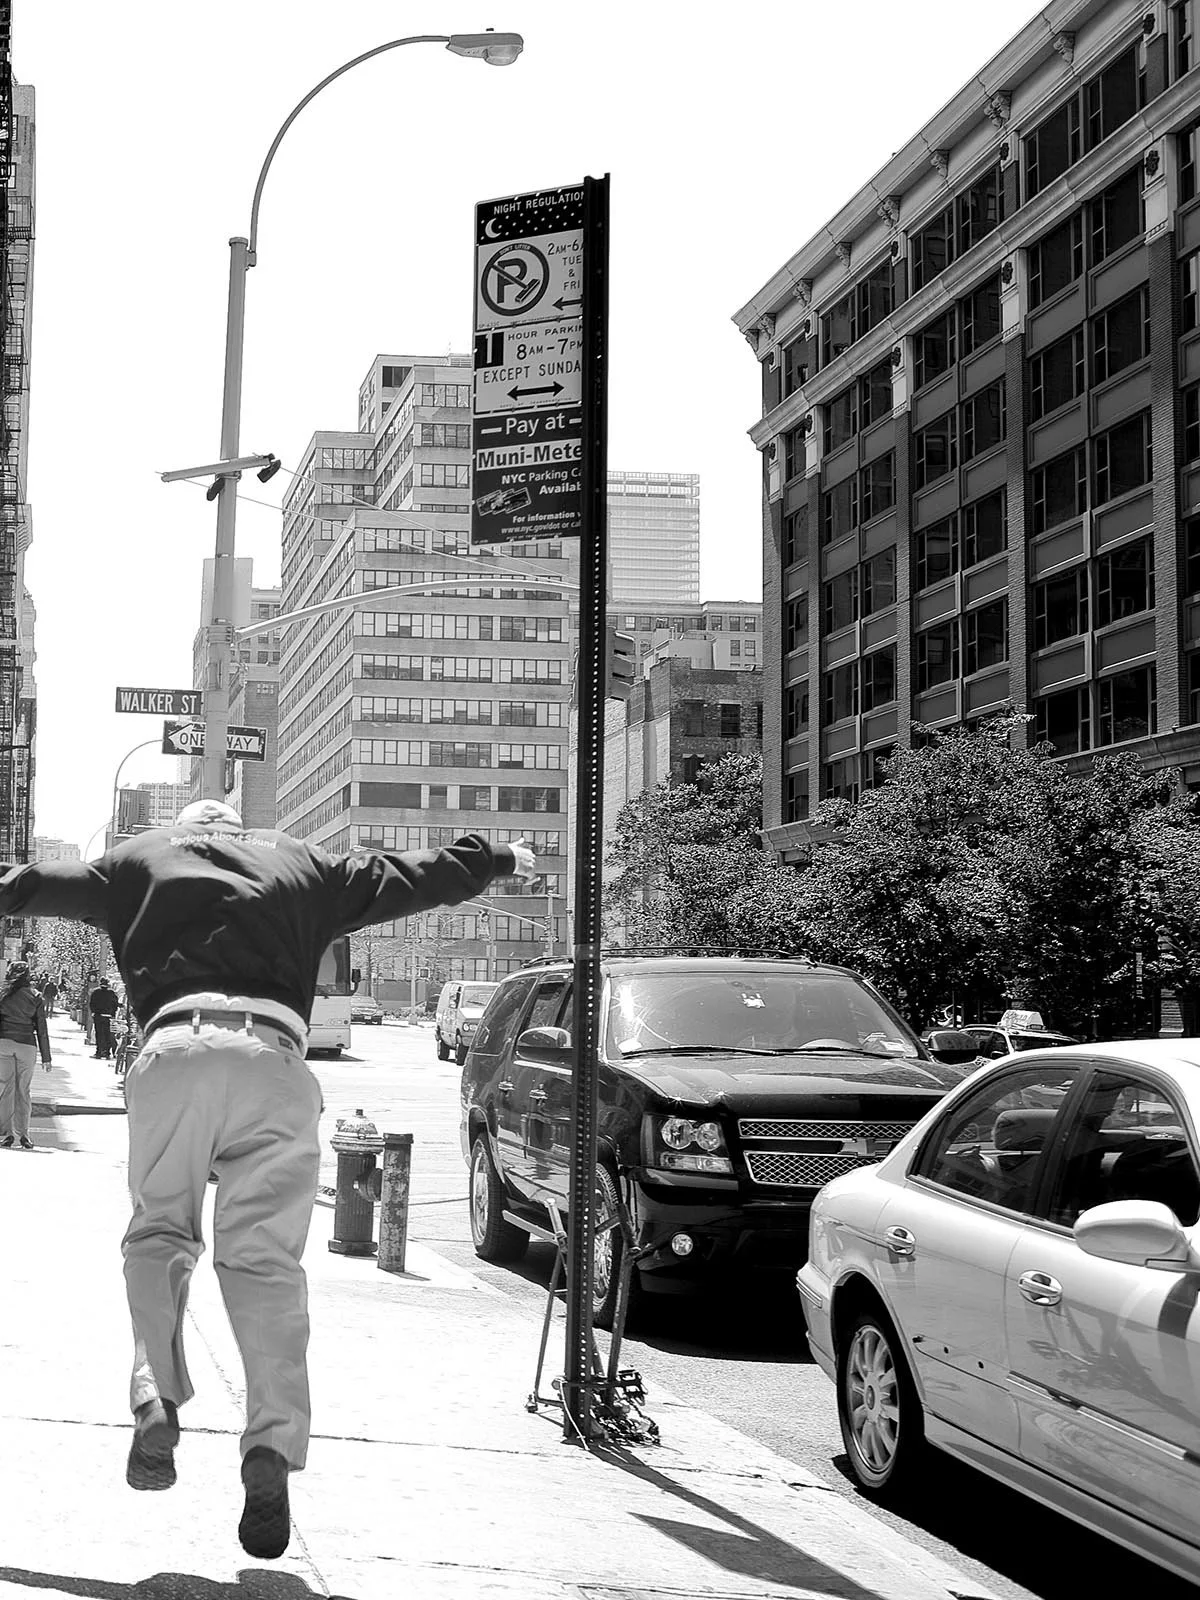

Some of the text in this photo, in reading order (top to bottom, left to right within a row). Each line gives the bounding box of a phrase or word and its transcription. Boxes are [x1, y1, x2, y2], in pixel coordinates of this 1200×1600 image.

[494, 201, 521, 215] NIGHT
[562, 255, 581, 266] TUE
[569, 269, 575, 277] &
[564, 280, 580, 291] FRI
[485, 332, 493, 364] 1
[508, 330, 538, 341] HOUR
[483, 365, 530, 384] EXCEPT
[505, 412, 566, 437] Pay at
[501, 473, 526, 485] NYC
[528, 469, 568, 482] Parking
[512, 515, 526, 524] For
[527, 511, 575, 522] information
[120, 691, 197, 714] WALKER ST
[179, 732, 205, 747] ONE
[210, 831, 244, 842] About
[245, 834, 277, 849] Sound
